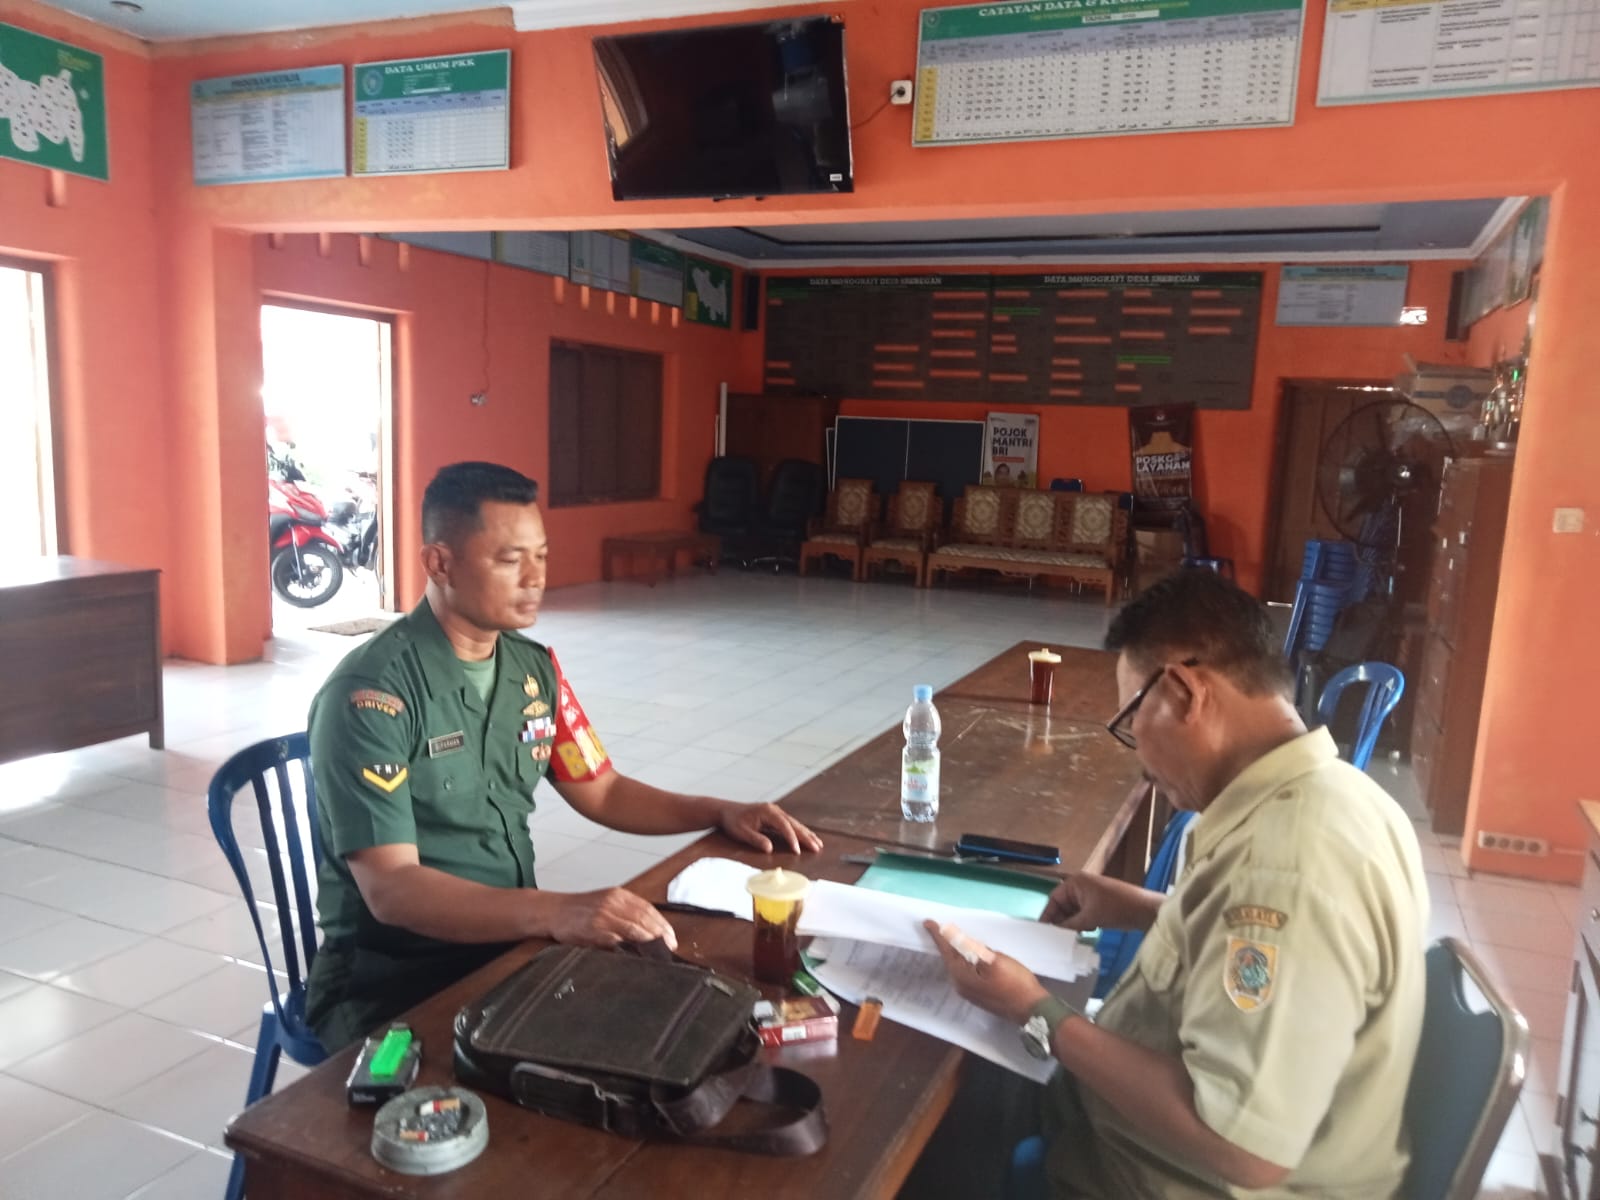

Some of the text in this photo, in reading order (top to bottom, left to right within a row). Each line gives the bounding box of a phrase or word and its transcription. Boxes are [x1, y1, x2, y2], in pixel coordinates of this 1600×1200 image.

[978, 3, 1041, 16] CATATAN
[1044, 0, 1082, 10] DATA
[384, 58, 475, 74] DATA UMUM PKK
[993, 427, 1027, 437] POJOK
[992, 437, 1033, 448] MANTRI
[1136, 461, 1190, 472] LAYANAN
[356, 700, 397, 717] DRIVER
[373, 763, 399, 774] TNI
